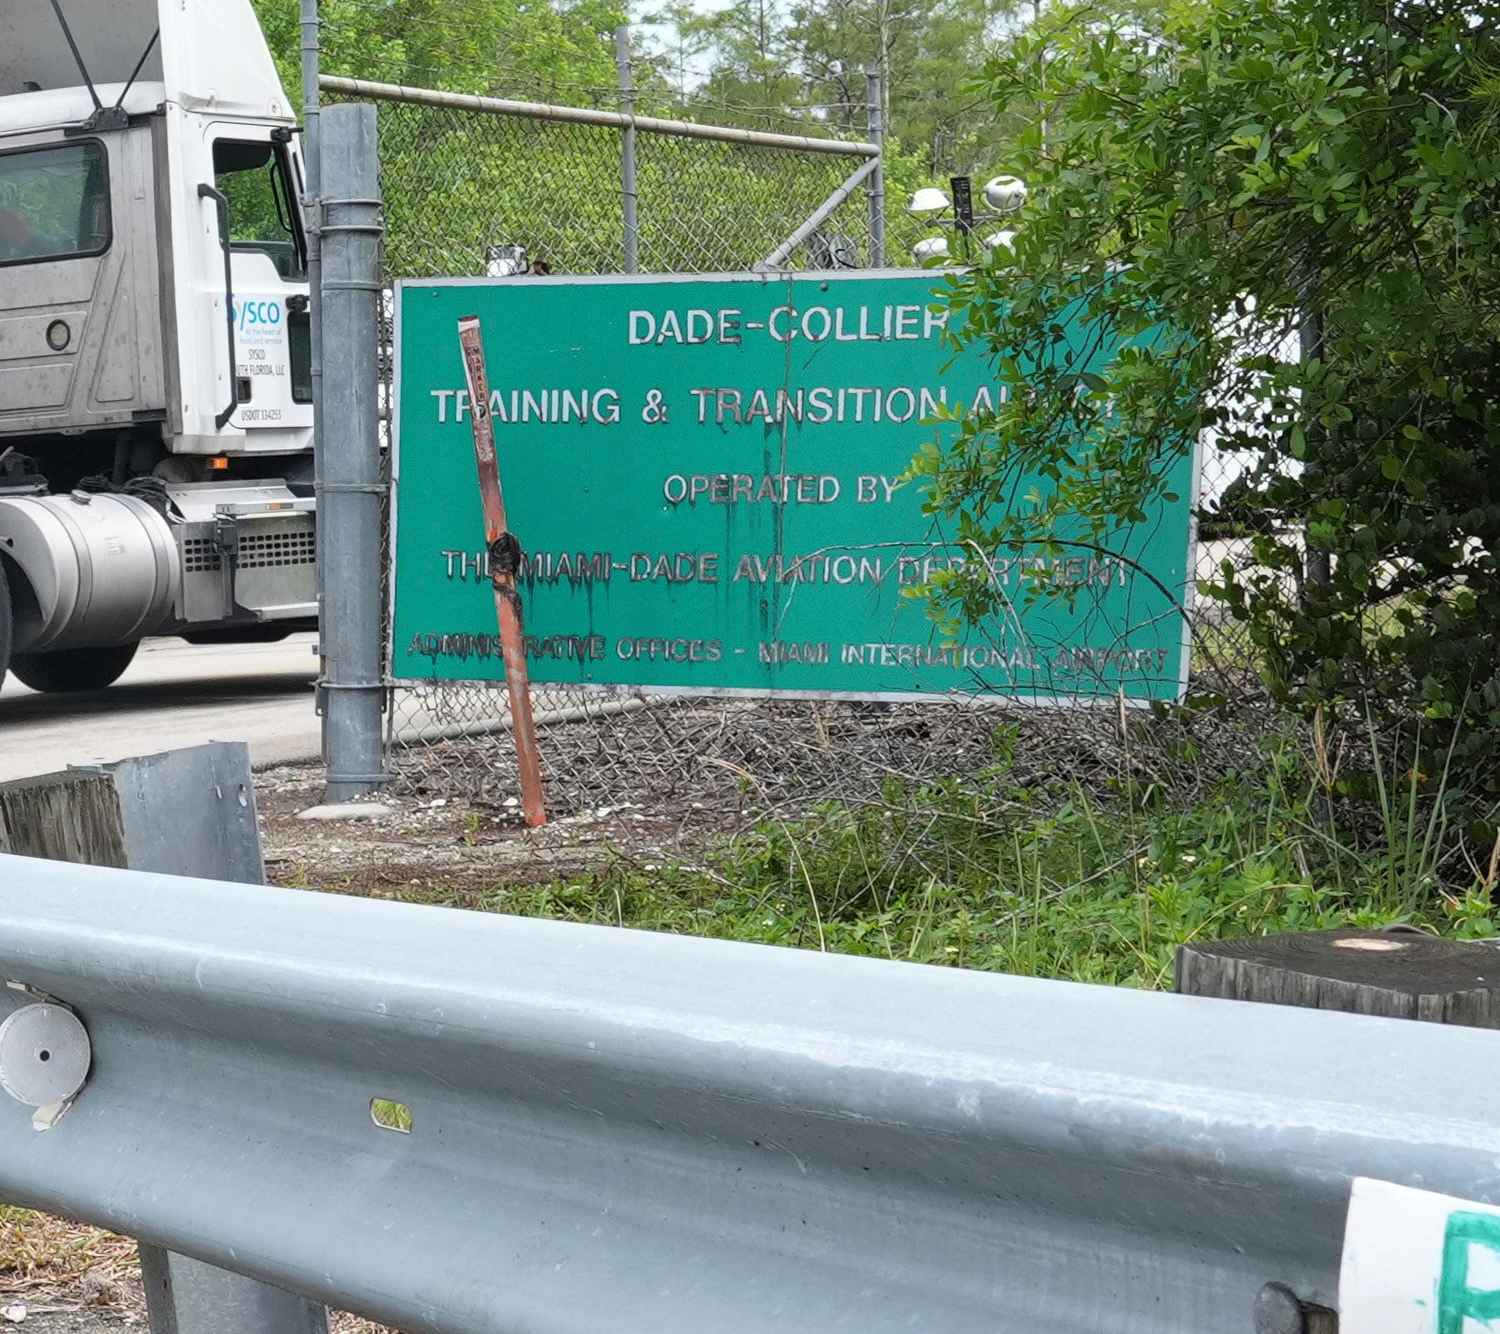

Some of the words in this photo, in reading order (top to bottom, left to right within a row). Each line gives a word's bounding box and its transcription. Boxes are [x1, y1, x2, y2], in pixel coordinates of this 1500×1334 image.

[628, 304, 949, 346] DADE-COLLIER
[641, 388, 670, 425] &
[690, 387, 948, 425] TRANSITION
[662, 474, 841, 505] OPERATED
[857, 474, 898, 504] BY
[519, 551, 719, 584] MIAMI-DADE
[733, 554, 882, 585] AVIATION
[407, 632, 606, 661] ADMINISRATIVE
[616, 639, 723, 663] OFFICES
[758, 641, 829, 665] MIAMI
[840, 643, 1040, 670] INTERNATIONAL
